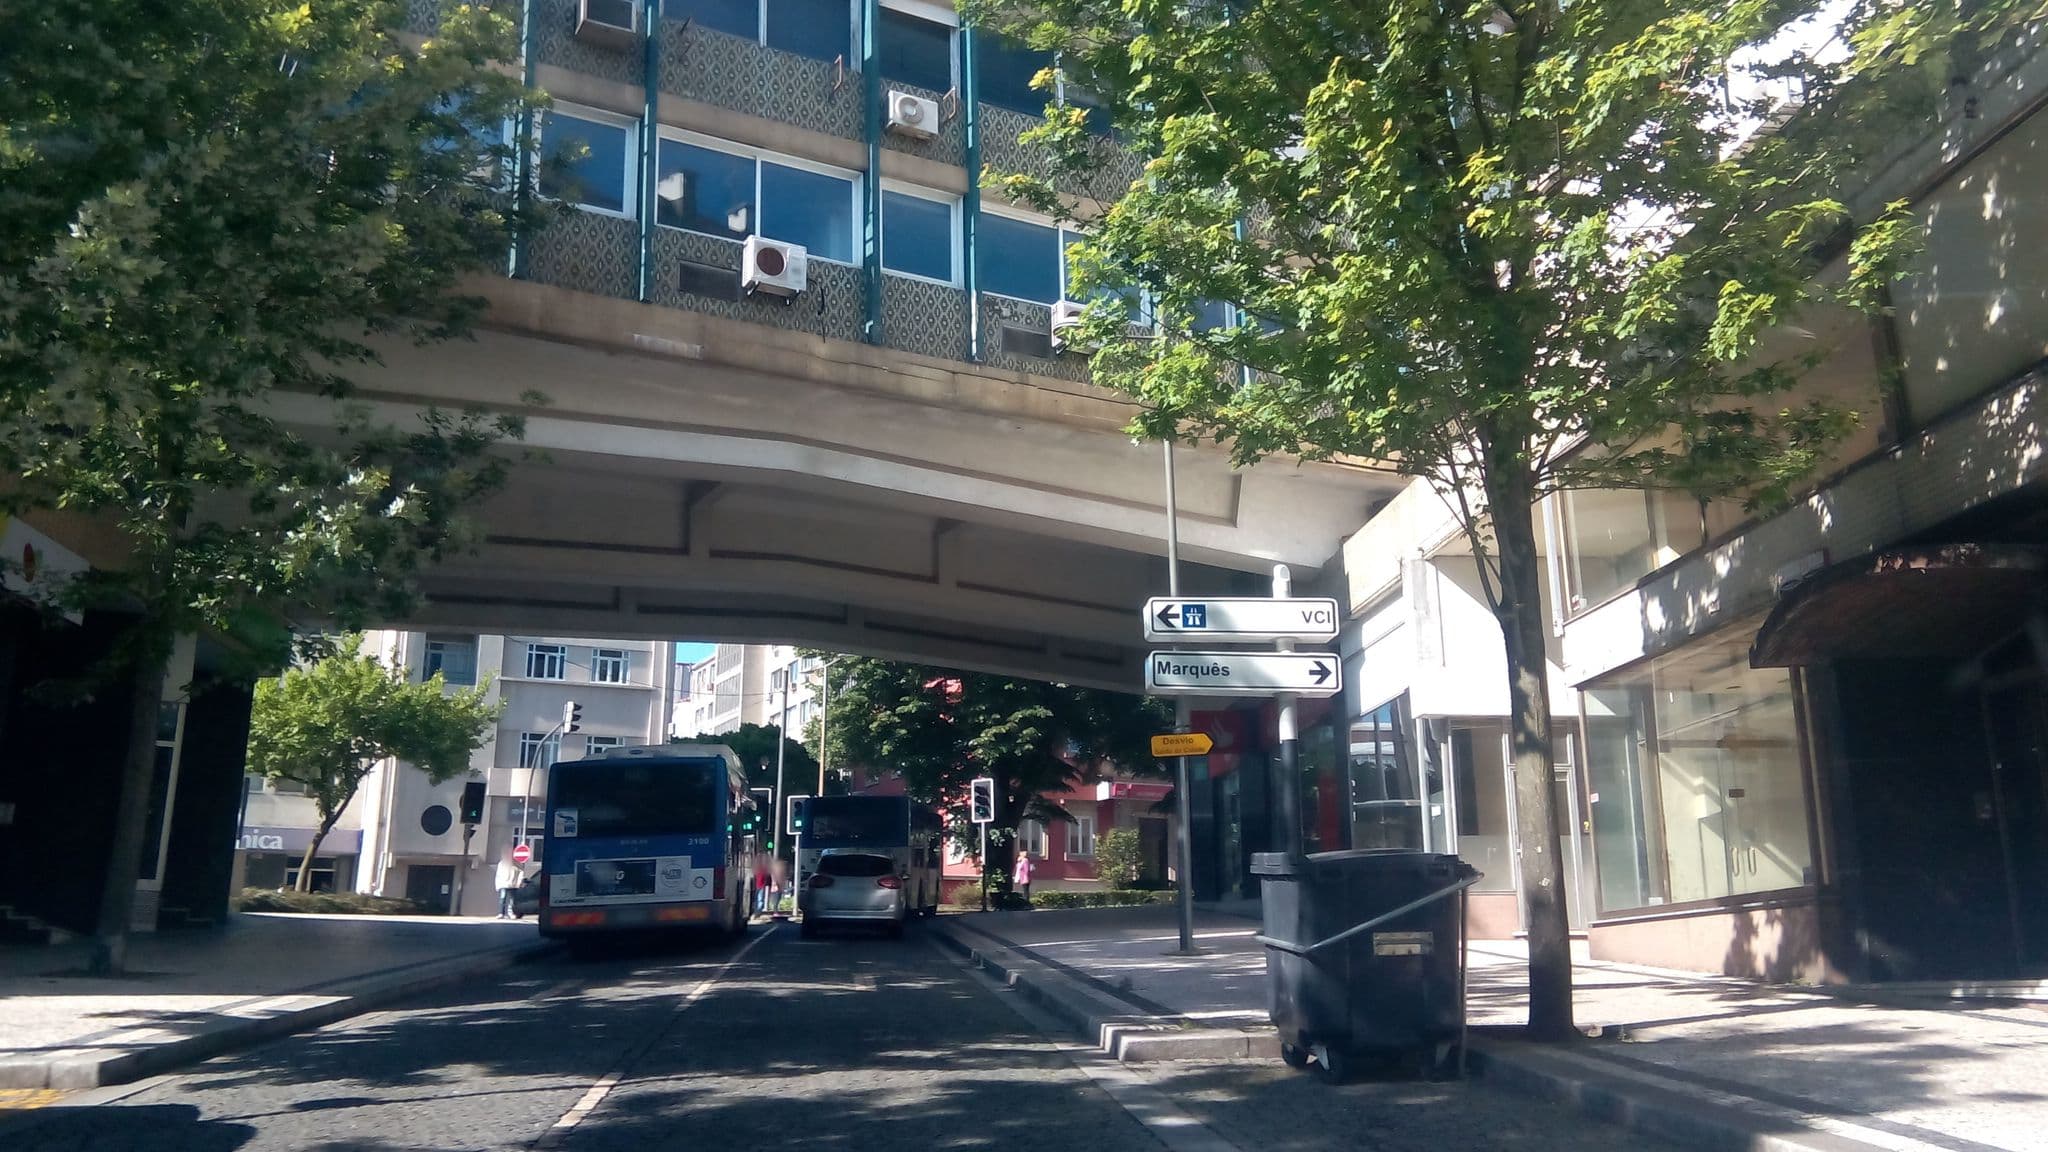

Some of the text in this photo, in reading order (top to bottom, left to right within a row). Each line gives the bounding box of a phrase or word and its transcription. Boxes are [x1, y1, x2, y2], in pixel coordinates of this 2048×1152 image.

[1301, 610, 1331, 624] VCI
[1157, 661, 1230, 678] Marquês
[1162, 736, 1195, 745] Desvio
